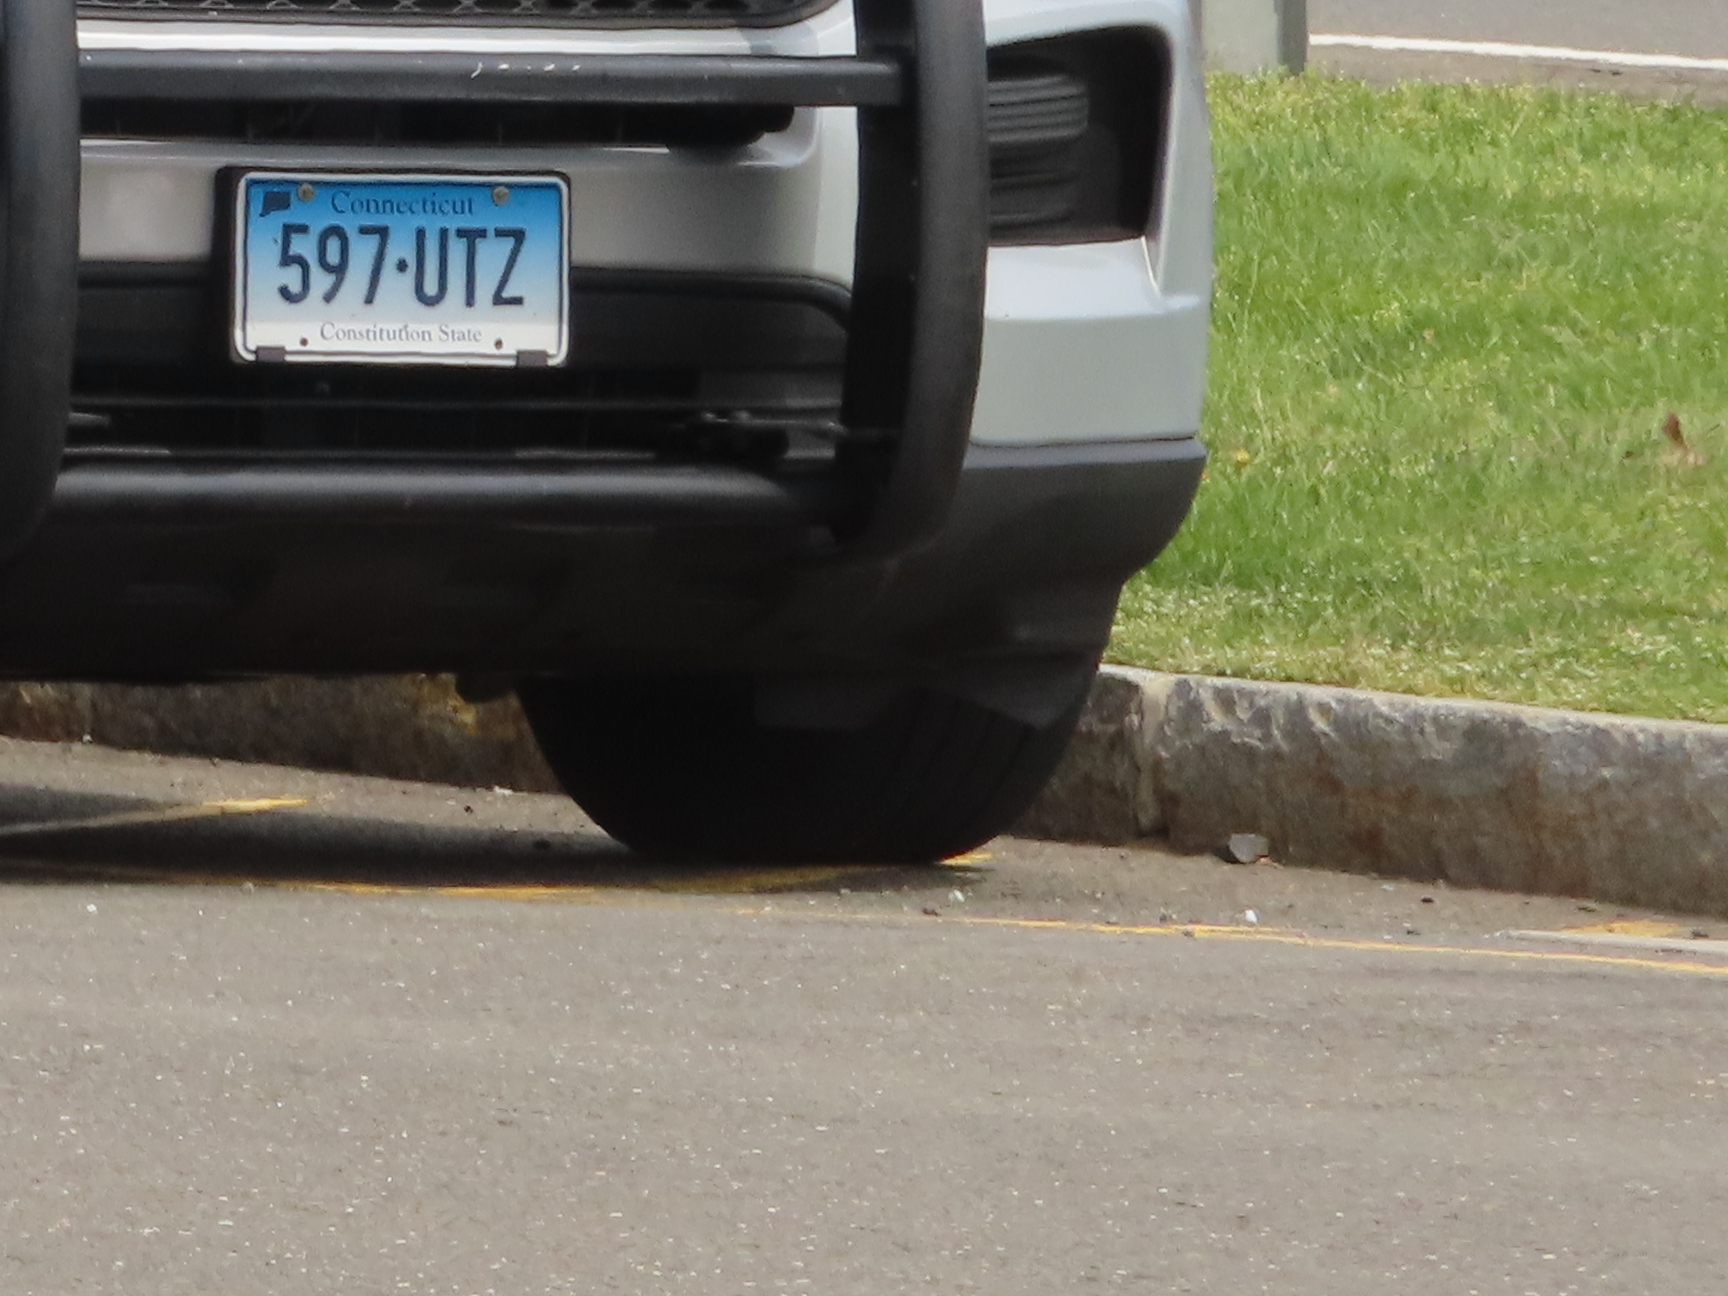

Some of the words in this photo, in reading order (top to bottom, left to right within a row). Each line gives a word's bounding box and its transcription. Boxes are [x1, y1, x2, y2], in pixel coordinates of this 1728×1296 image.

[331, 190, 476, 216] Connecticut
[320, 322, 434, 344] Constitution
[438, 324, 483, 344] State
